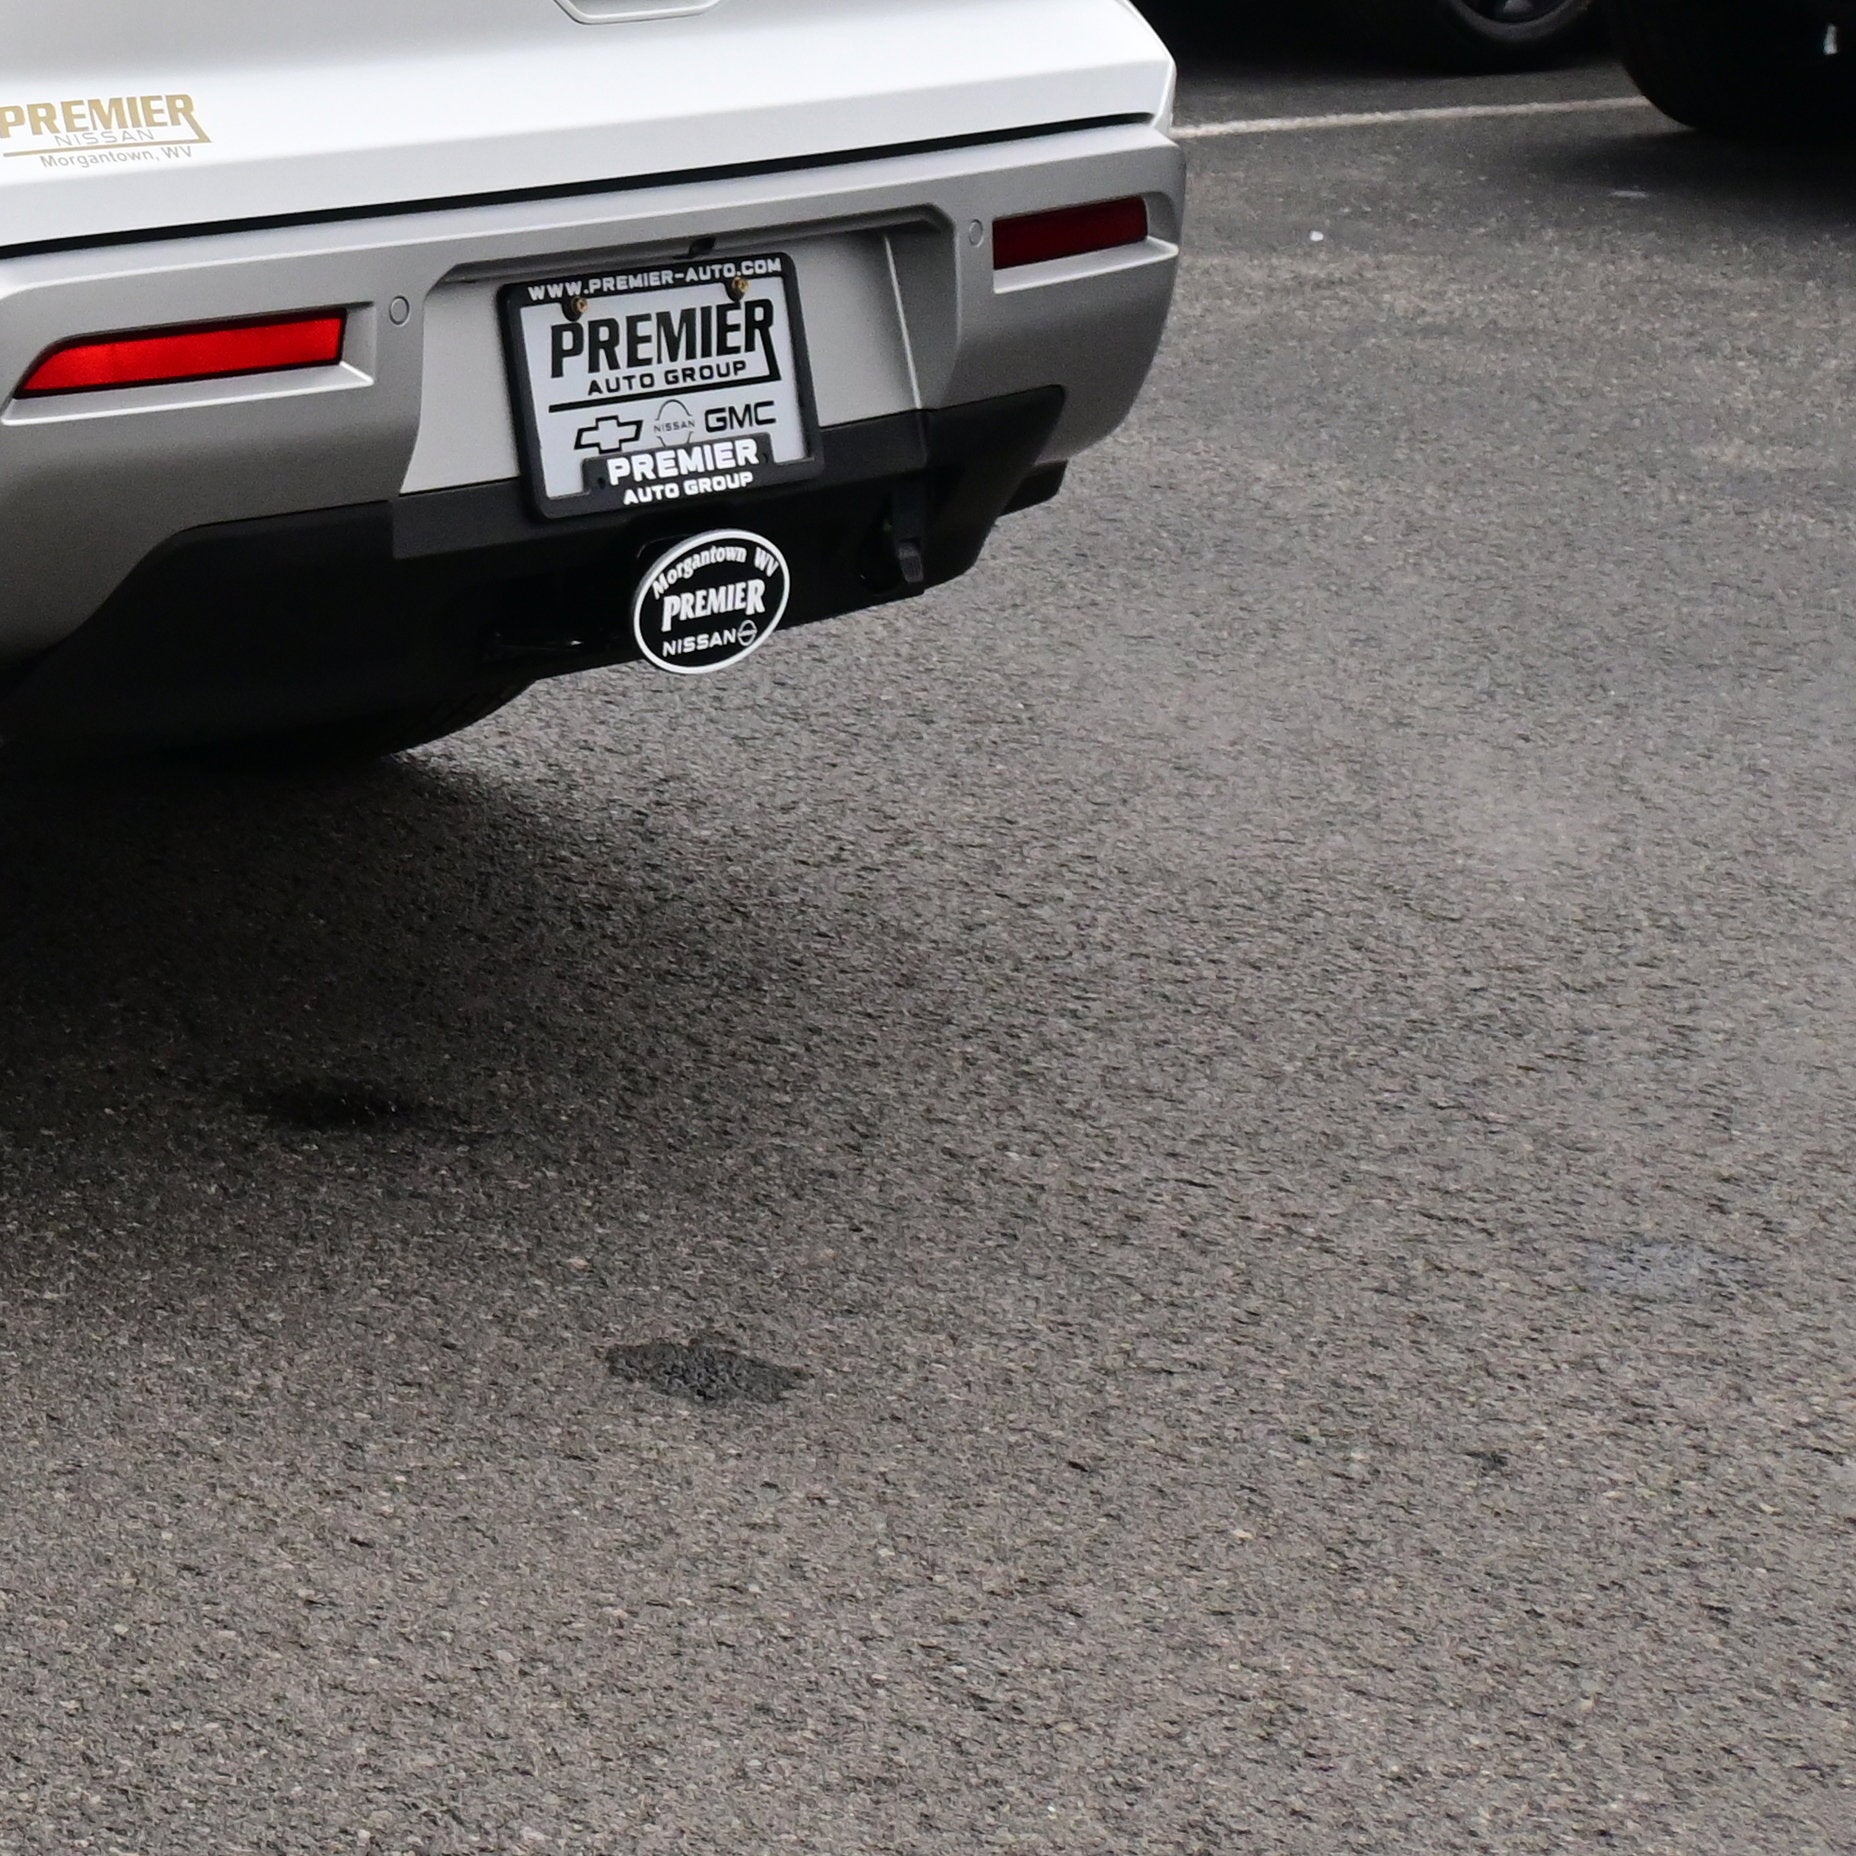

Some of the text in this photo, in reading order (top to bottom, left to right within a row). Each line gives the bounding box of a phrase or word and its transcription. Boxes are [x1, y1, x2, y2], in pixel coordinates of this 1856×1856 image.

[54, 129, 154, 146] NISSAN
[40, 146, 192, 168] Morgantown, WV
[528, 258, 782, 301] WWW.PREMIER-AUTO.COM
[551, 298, 781, 380] PREMIER
[588, 360, 746, 395] AUTO GROUP
[653, 400, 776, 433] NISSAN GMC
[606, 438, 760, 486] PREMIER
[623, 471, 754, 505] AUTO GROUP
[652, 545, 779, 600] Morgantown WV
[661, 578, 766, 633] PREMIER
[662, 628, 737, 657] NISSAN
